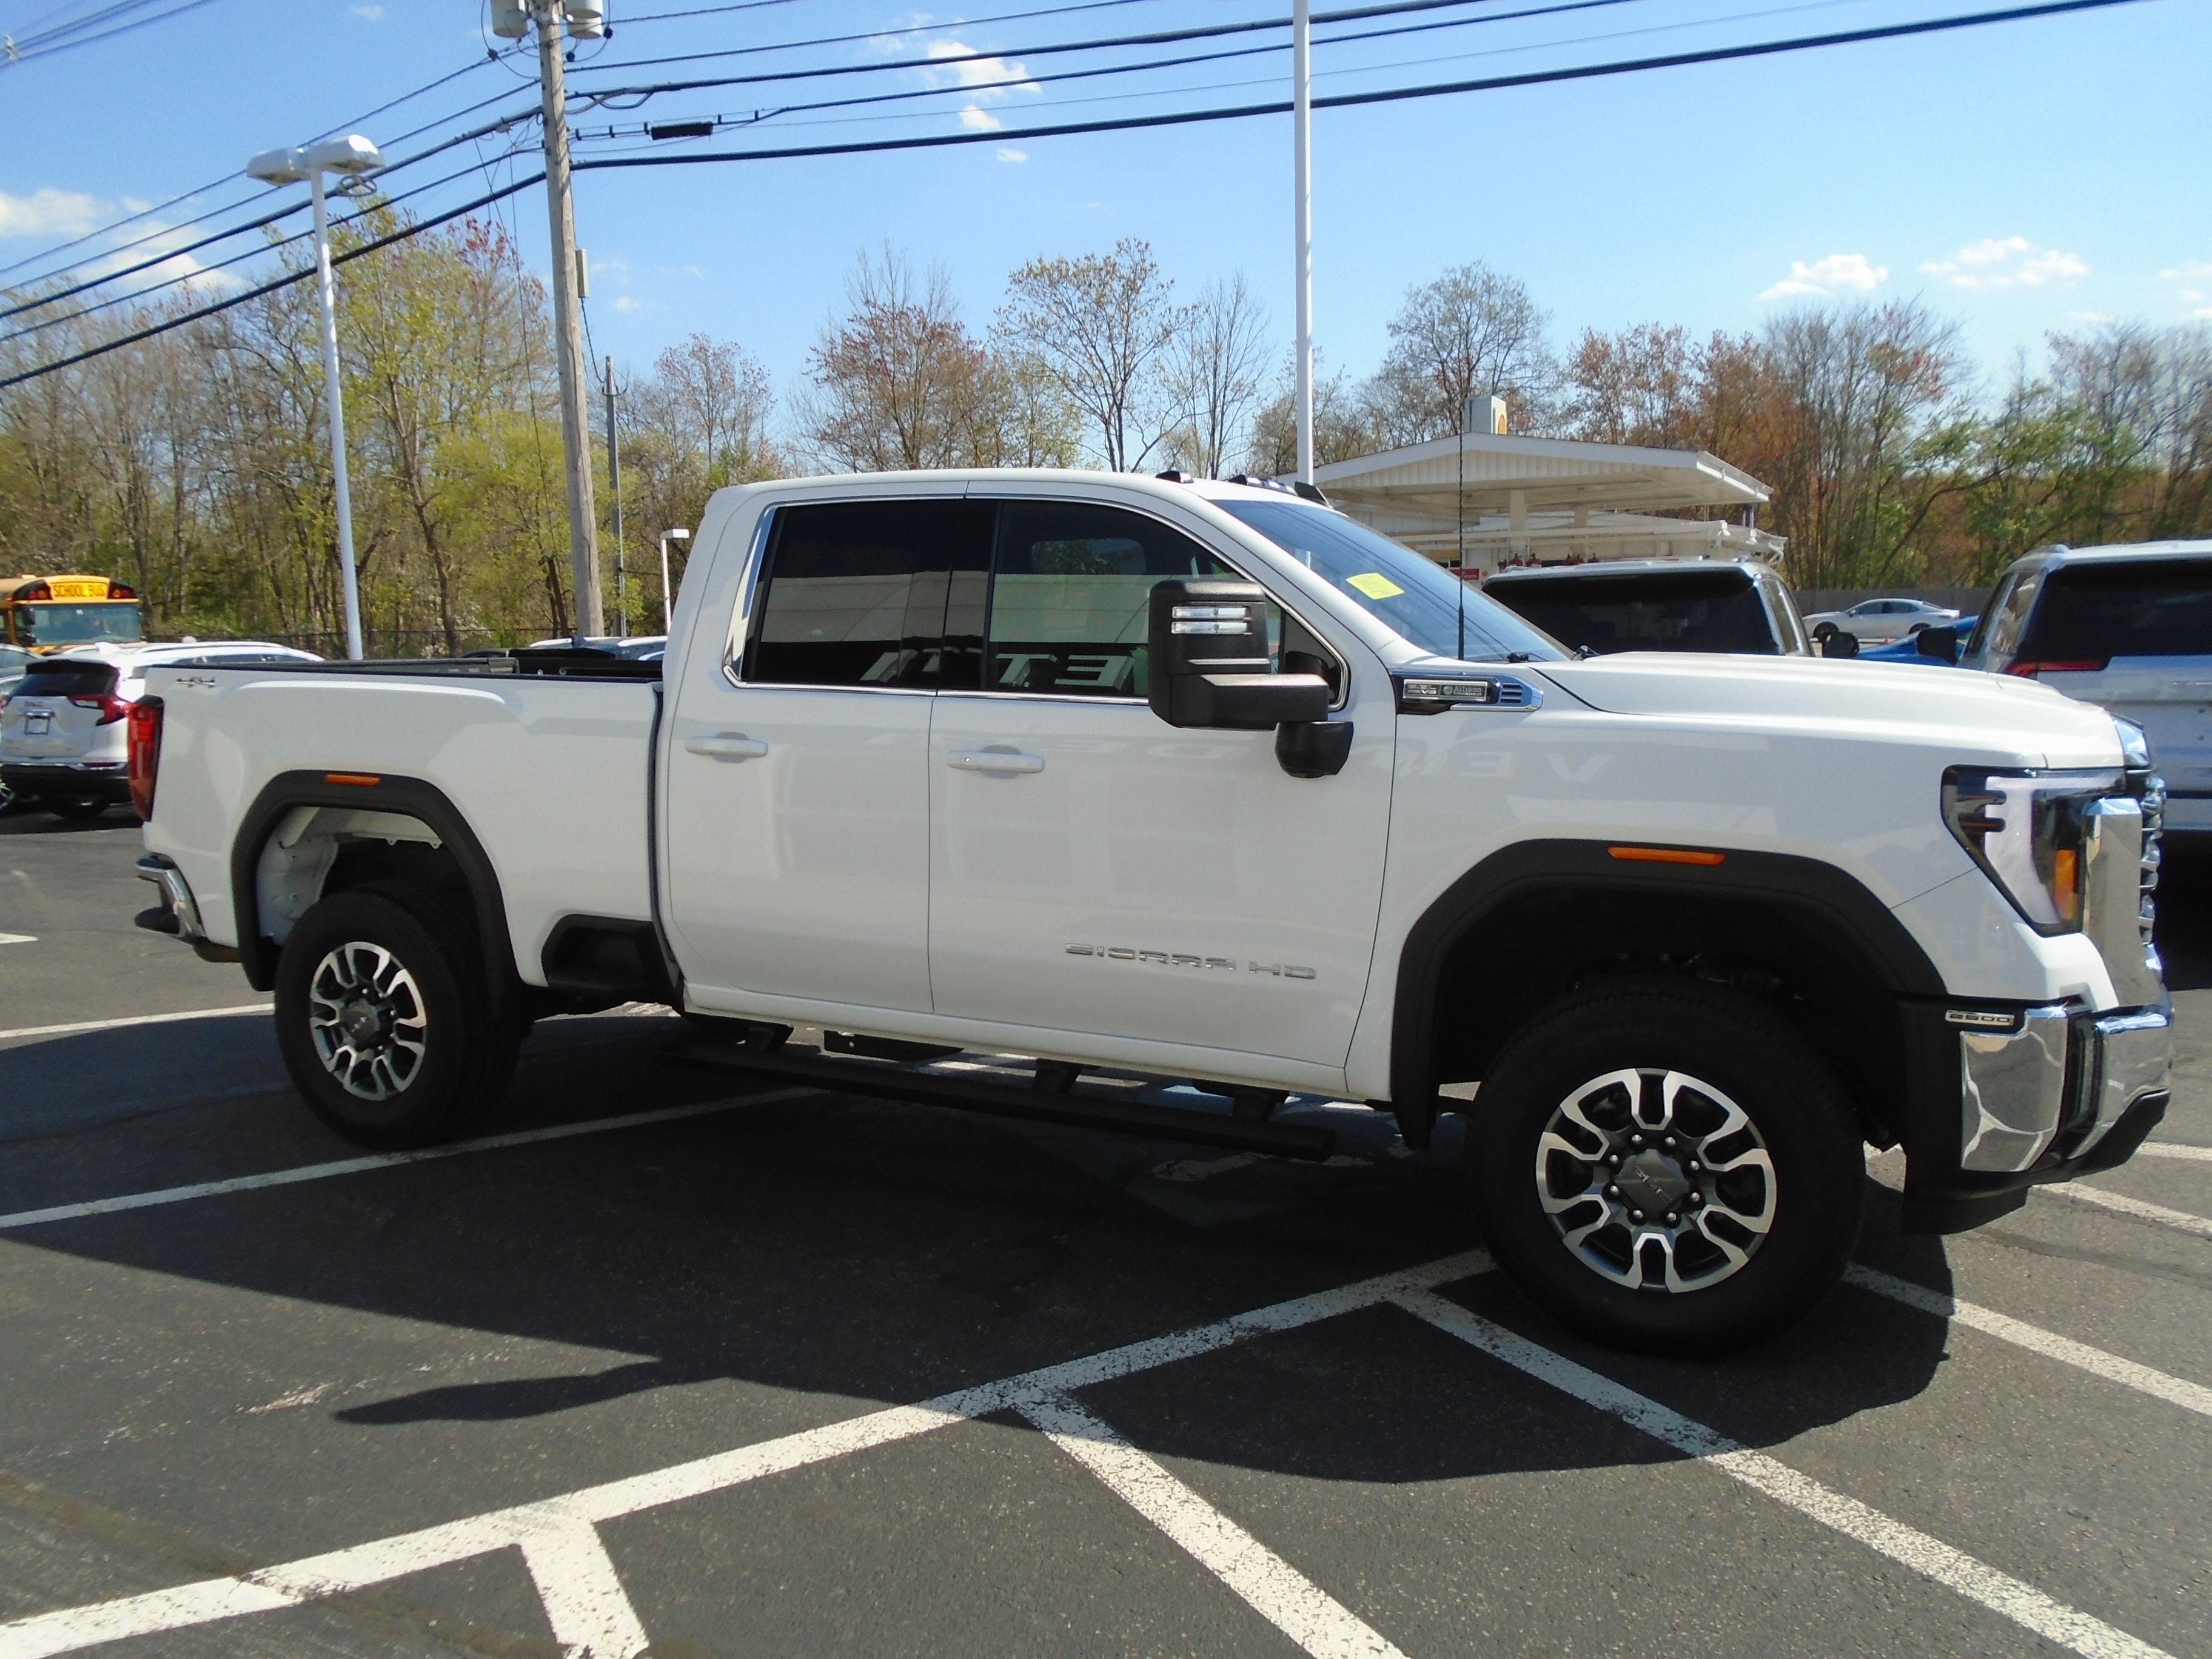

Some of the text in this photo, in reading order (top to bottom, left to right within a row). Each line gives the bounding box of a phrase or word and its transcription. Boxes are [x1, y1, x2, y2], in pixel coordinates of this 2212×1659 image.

[53, 584, 106, 597] SCHOOL BUS
[1065, 942, 1316, 979] SIERRA HD
[1631, 1165, 1672, 1204] GMC
